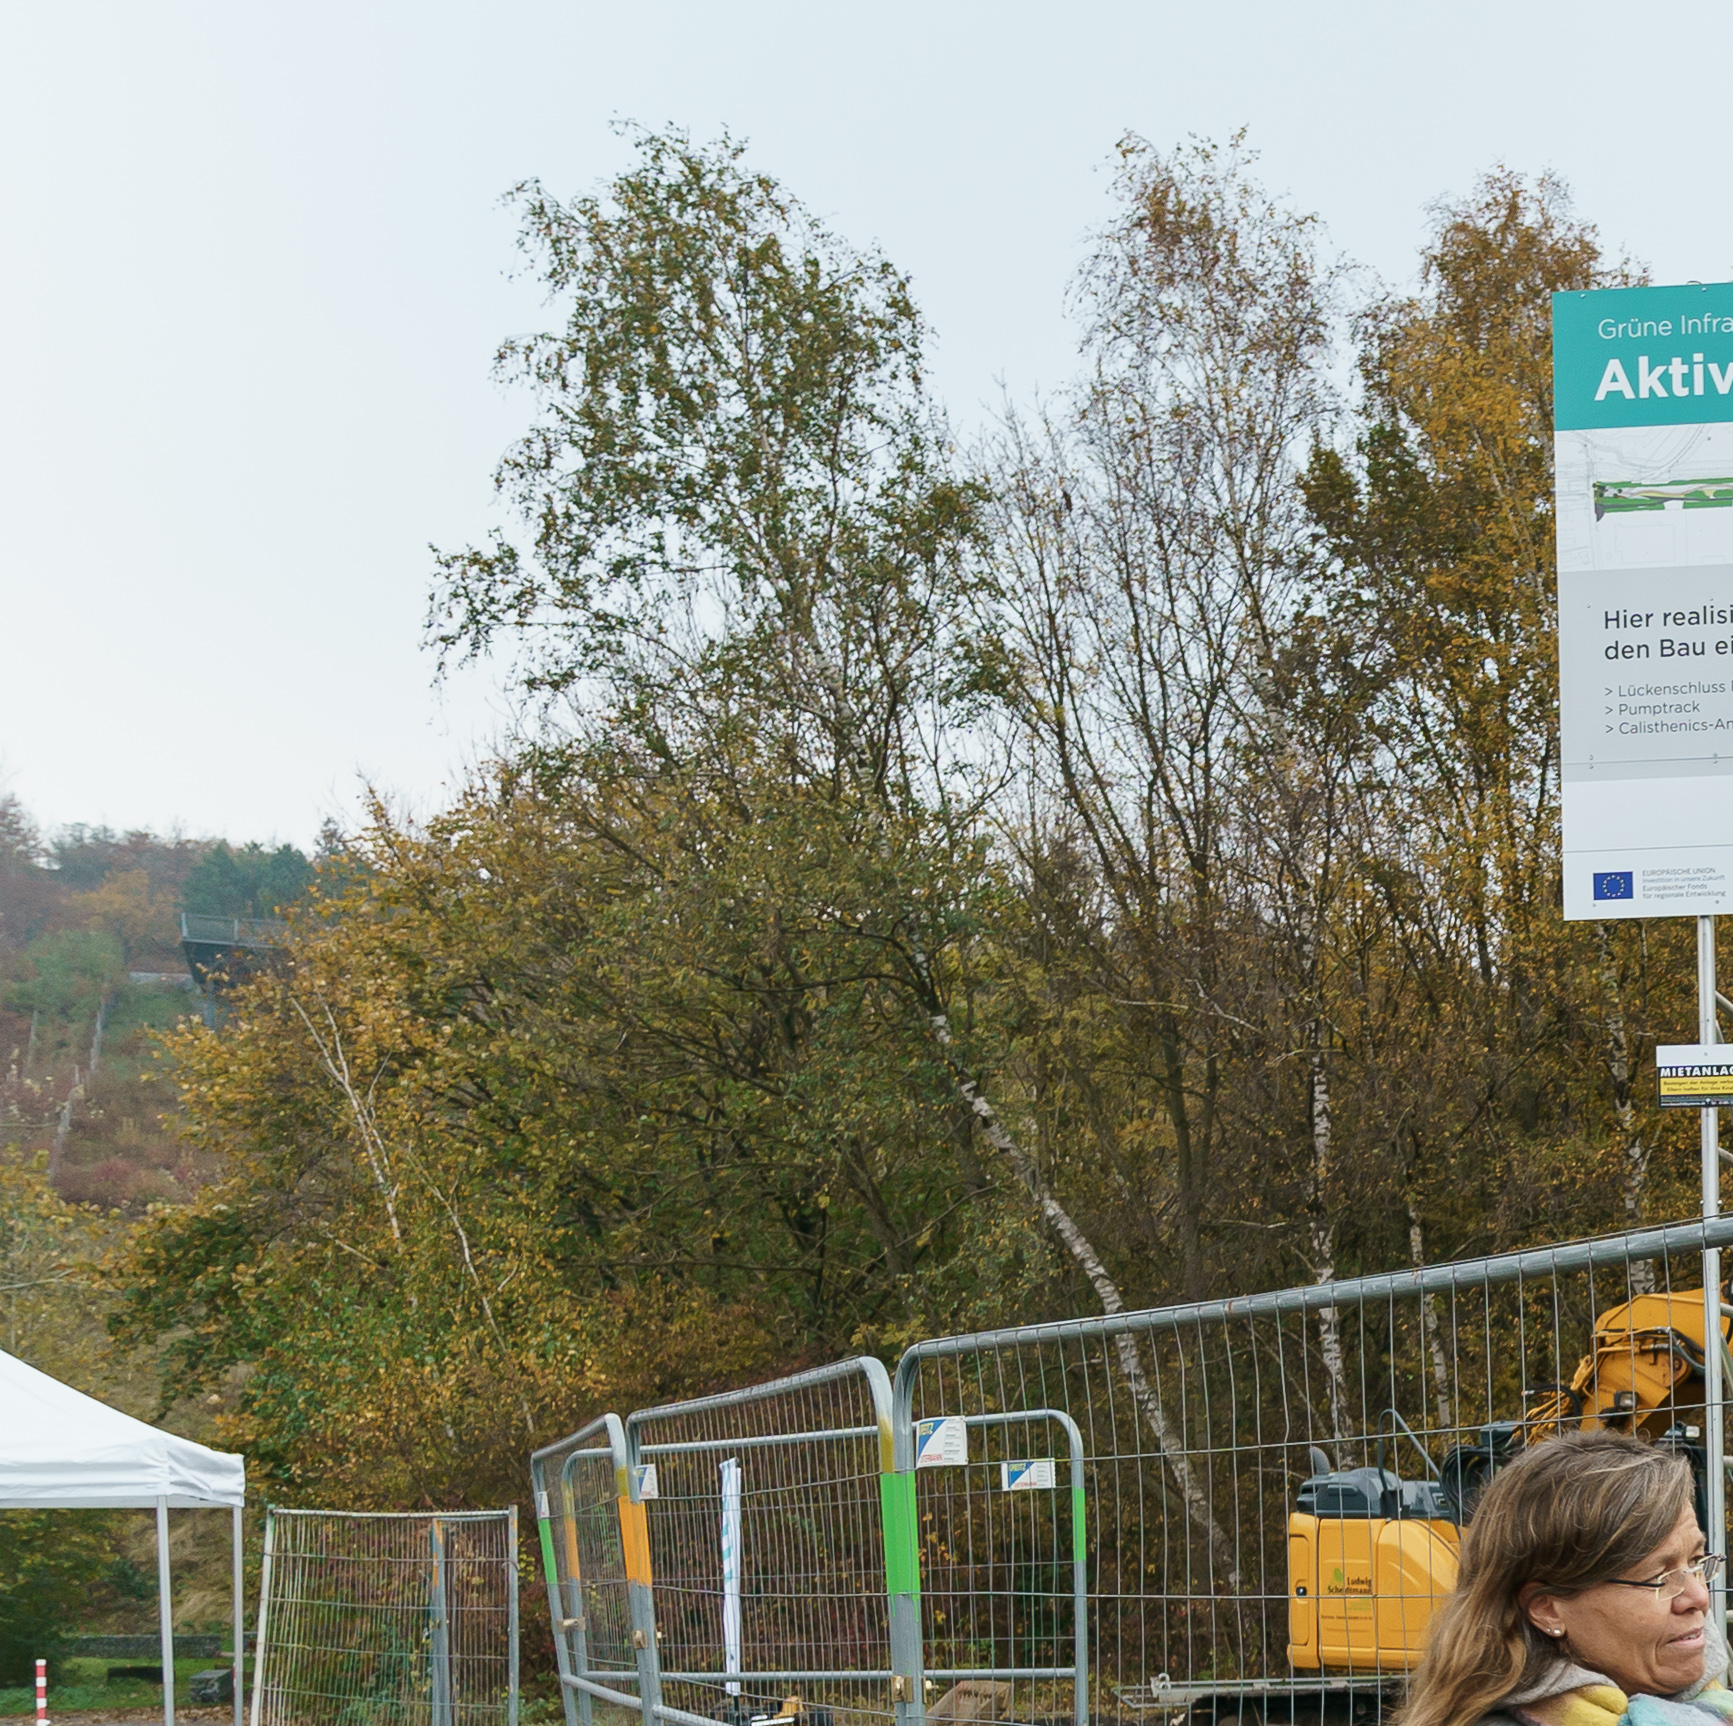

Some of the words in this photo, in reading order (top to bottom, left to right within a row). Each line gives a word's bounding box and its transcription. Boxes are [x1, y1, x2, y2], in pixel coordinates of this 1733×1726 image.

[1598, 318, 1672, 341] Grüne
[1604, 610, 1654, 629] Hier
[1605, 641, 1650, 660] den
[1660, 636, 1706, 658] Bau
[1618, 679, 1726, 698] Lückenschluss
[1618, 700, 1700, 718] Pumptrack
